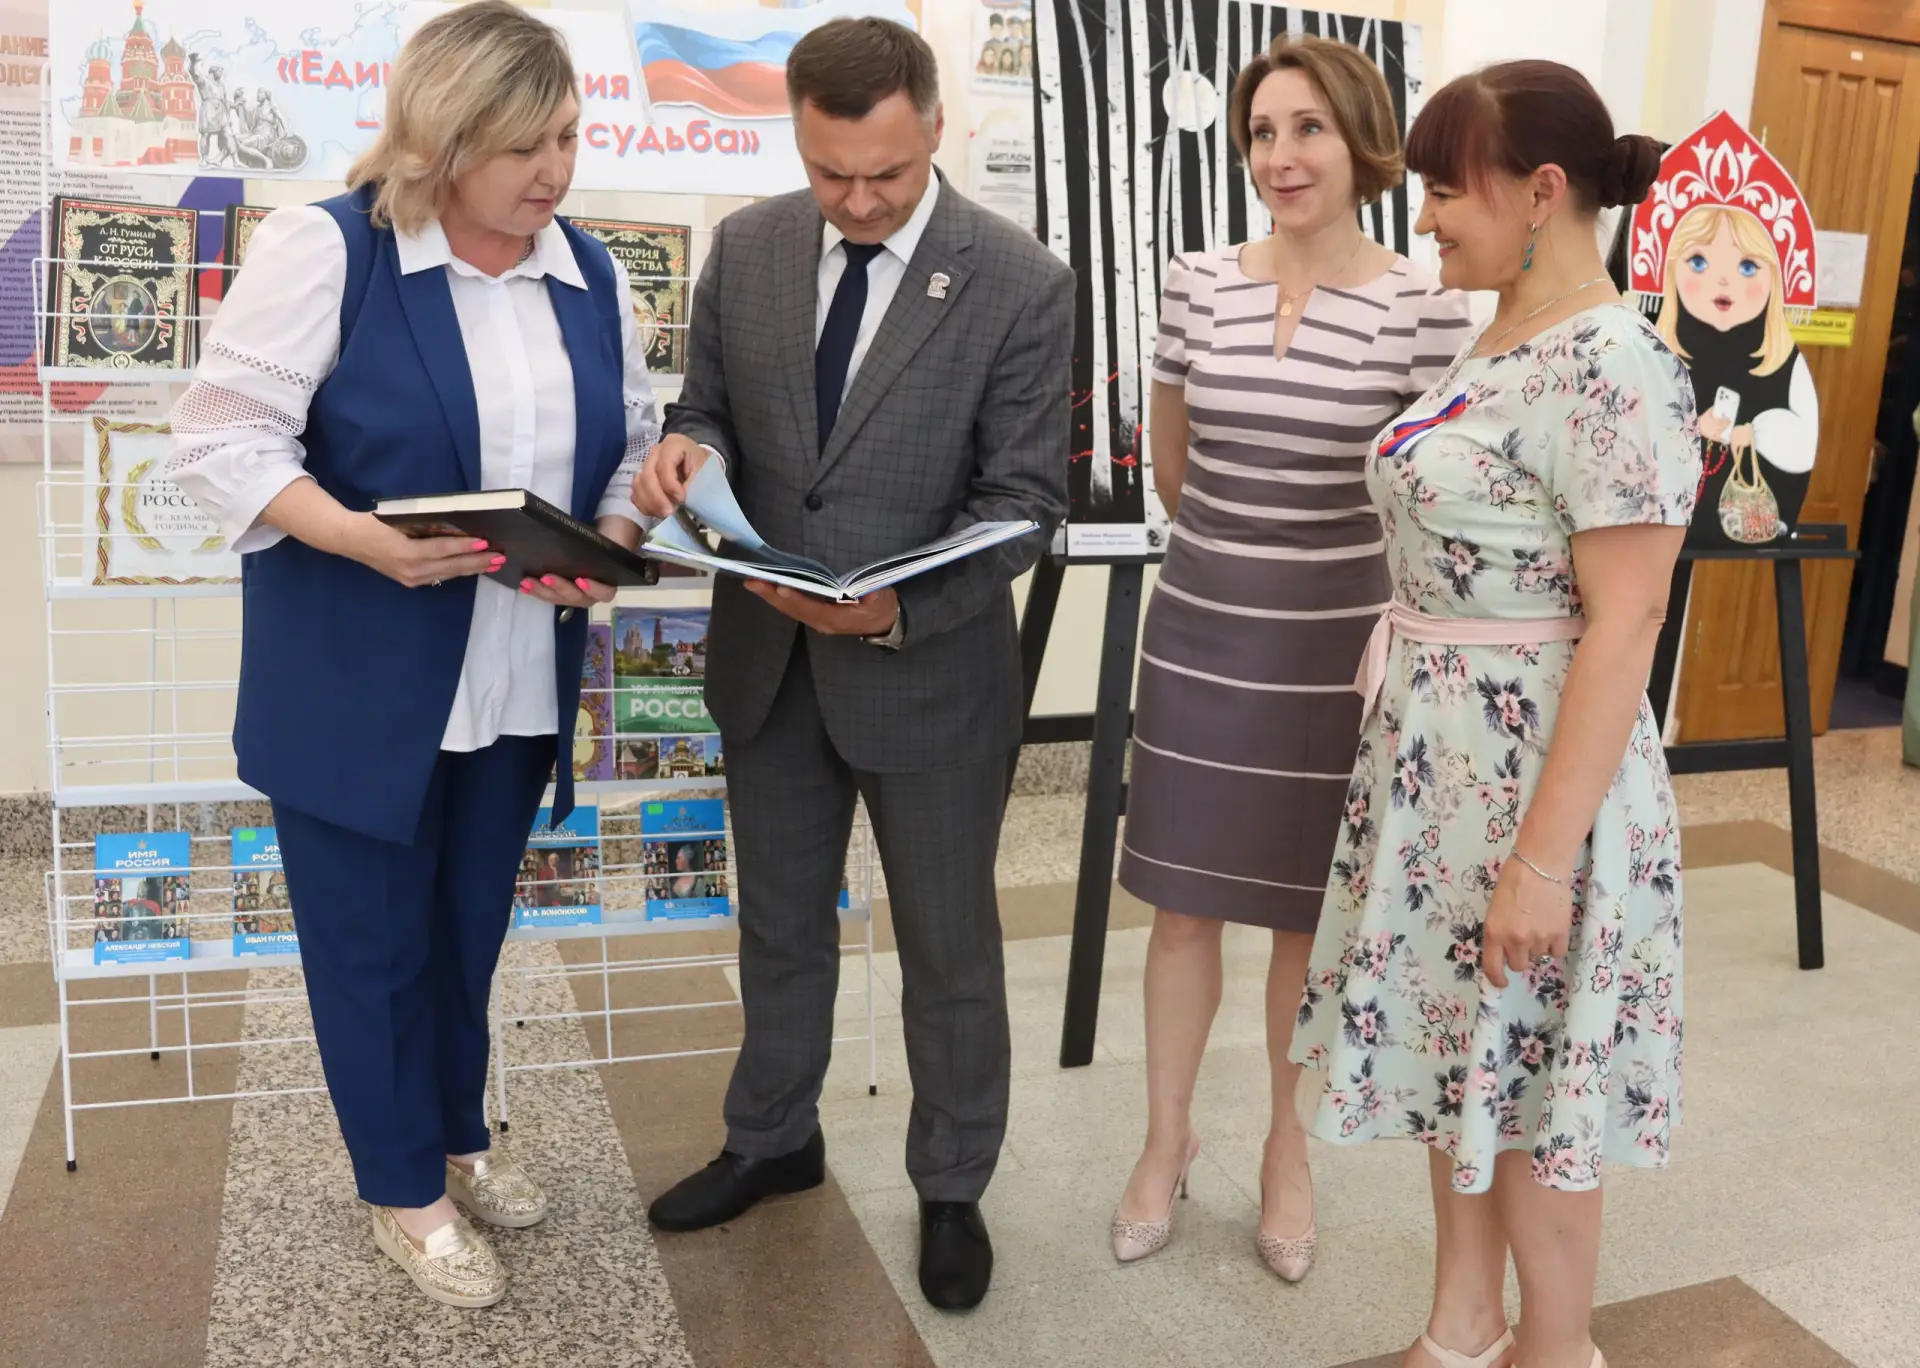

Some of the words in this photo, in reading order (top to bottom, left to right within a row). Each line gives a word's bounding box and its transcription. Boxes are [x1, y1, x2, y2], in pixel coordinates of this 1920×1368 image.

[584, 119, 760, 158] судьба»
[986, 152, 1032, 162] ДИПЛОМ
[110, 227, 119, 236] Н.
[100, 243, 118, 255] ОТ
[119, 244, 154, 258] РУСИ
[104, 257, 159, 271] РОССИИ
[143, 494, 198, 507] РОСС
[128, 850, 158, 859] ИМЯ
[115, 858, 170, 868] РОССИЯ
[105, 942, 147, 952] АЛЕКСАНДР
